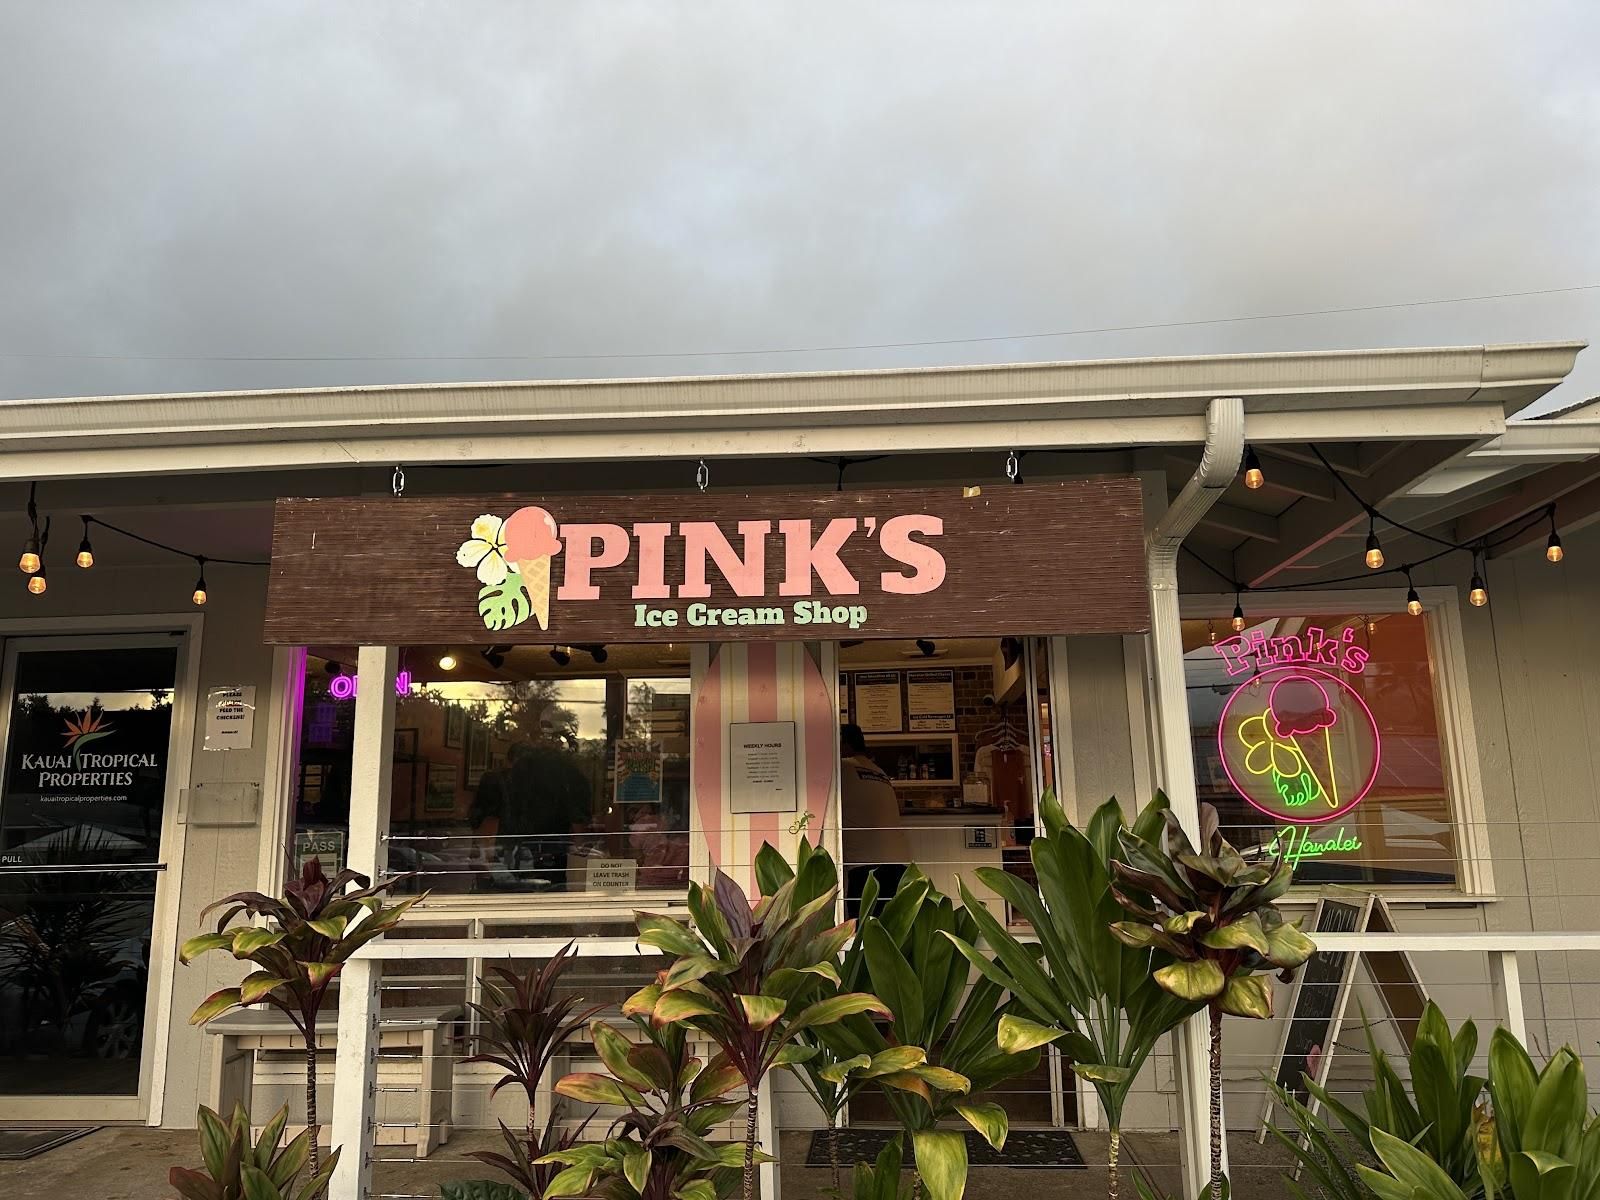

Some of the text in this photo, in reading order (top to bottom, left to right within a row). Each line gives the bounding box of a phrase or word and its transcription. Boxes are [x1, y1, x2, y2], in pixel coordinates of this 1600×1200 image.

[557, 514, 947, 600] PINK'S
[634, 601, 867, 629] Ice Cream Shop
[1214, 626, 1369, 676] Pink's
[21, 753, 157, 770] KAUAI TROPICAL
[38, 771, 133, 788] PROPERTIES
[40, 795, 128, 804] kauaitropicalproperties.com
[302, 840, 336, 852] PASS
[1, 855, 23, 863] PULL
